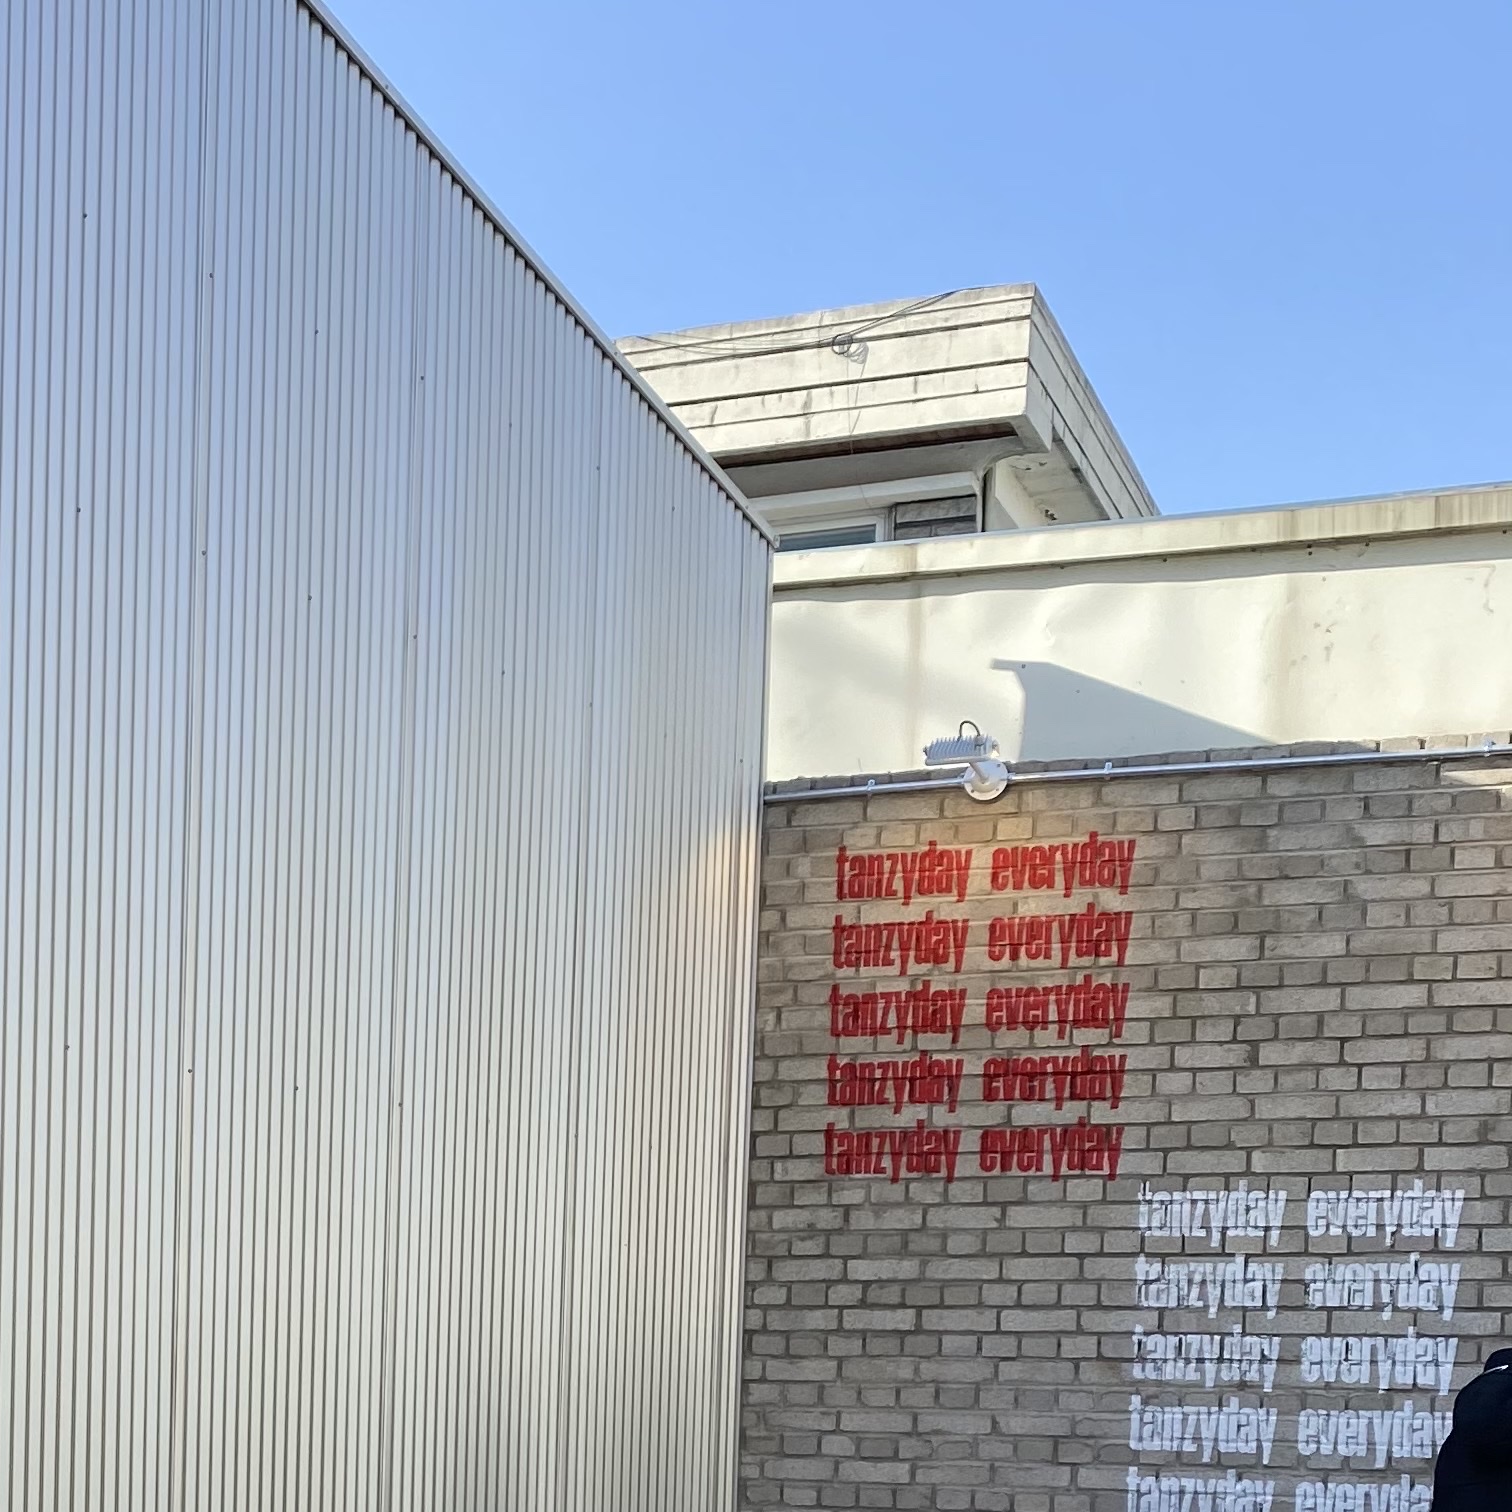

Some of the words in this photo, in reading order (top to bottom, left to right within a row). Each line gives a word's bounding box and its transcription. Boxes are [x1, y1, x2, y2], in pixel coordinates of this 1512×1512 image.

[837, 840, 973, 906] tanzyday
[991, 831, 1136, 897] everyday
[832, 910, 970, 976] tanzyday
[988, 902, 1134, 969] everyday
[830, 980, 967, 1045] tanzyday
[985, 974, 1130, 1040] everyday
[826, 1050, 964, 1115] tanzyday
[982, 1045, 1128, 1111] everyday
[824, 1119, 961, 1184] tanzyday
[979, 1116, 1125, 1182] everyday
[1138, 1179, 1287, 1247] tanzyday
[1307, 1178, 1465, 1247] everyday
[1135, 1253, 1283, 1319] tanzyday
[1305, 1252, 1461, 1320] everyday
[1132, 1323, 1282, 1392] tanzyday
[1299, 1325, 1458, 1395] everyday
[1129, 1394, 1278, 1465] tanzyday
[1297, 1400, 1453, 1468] everyday
